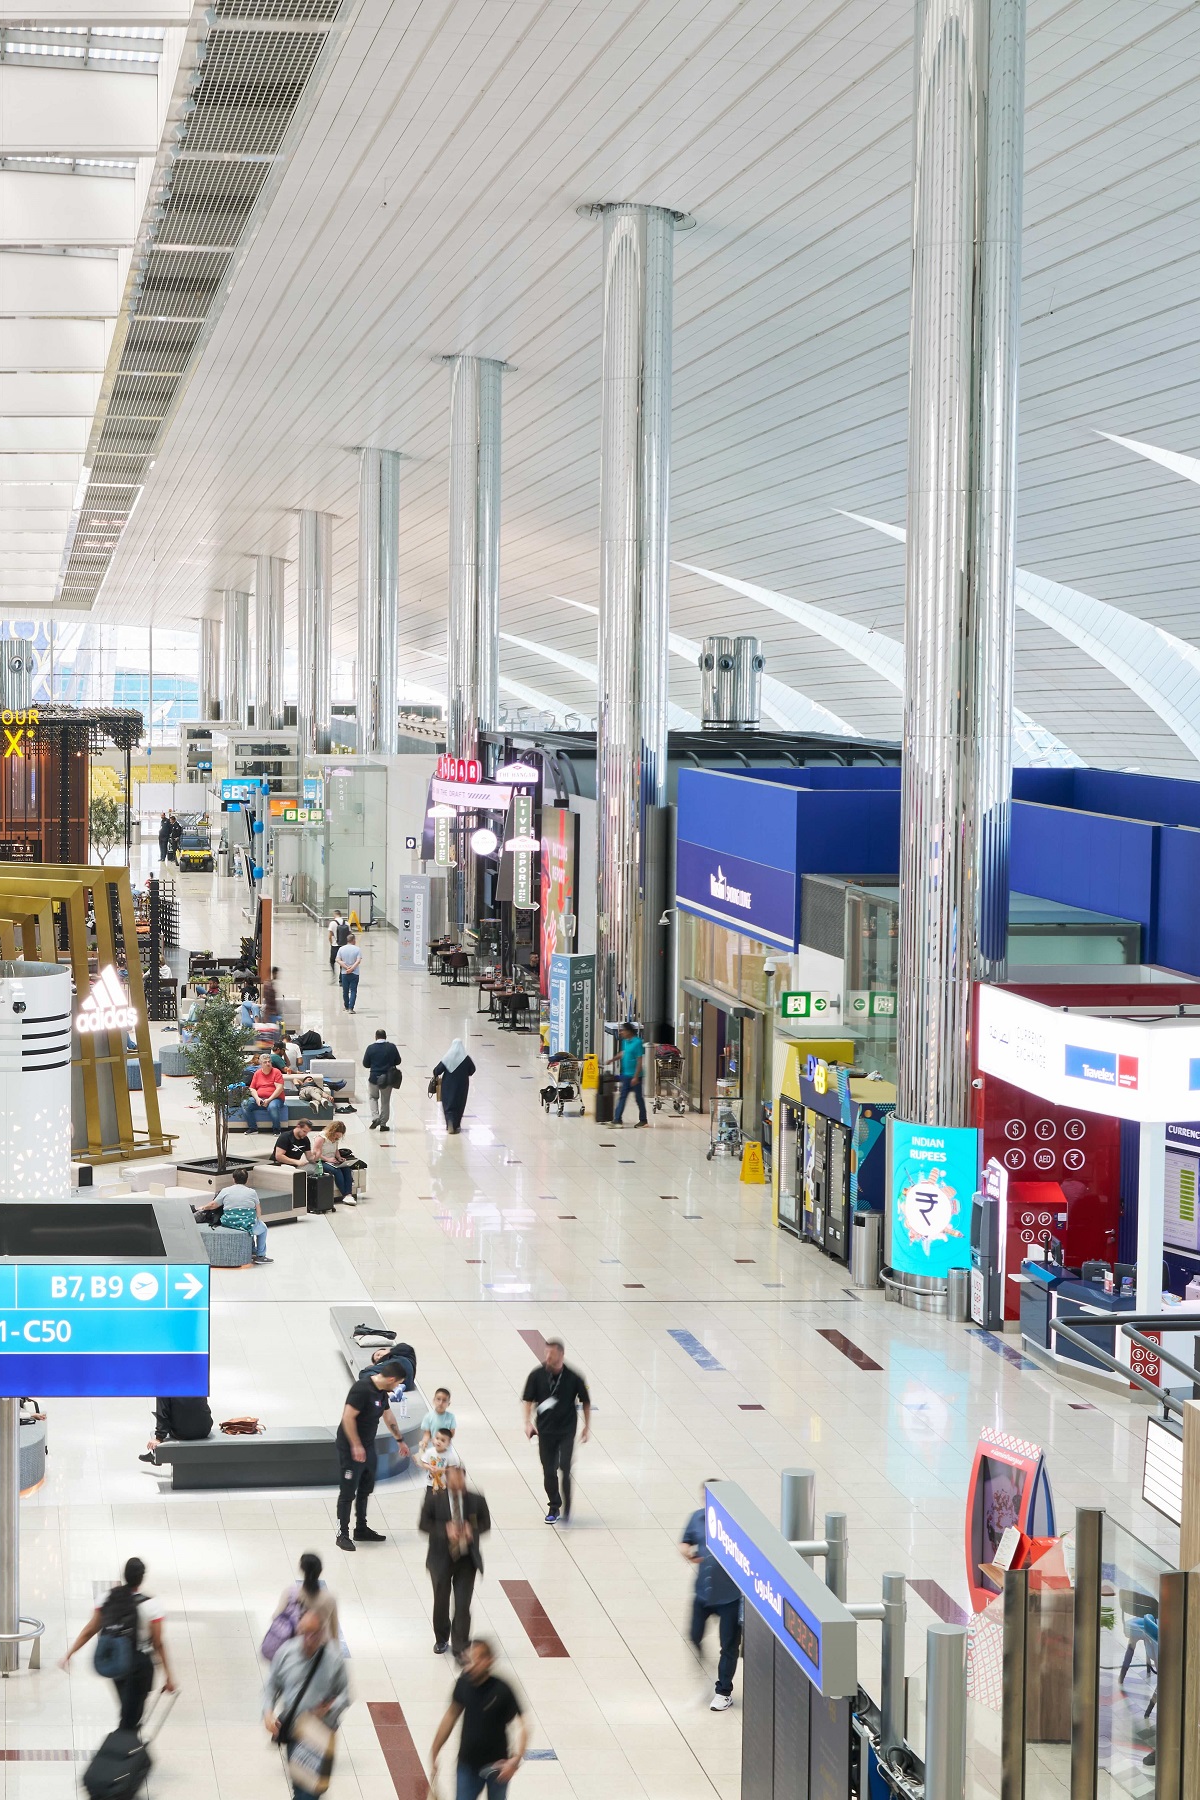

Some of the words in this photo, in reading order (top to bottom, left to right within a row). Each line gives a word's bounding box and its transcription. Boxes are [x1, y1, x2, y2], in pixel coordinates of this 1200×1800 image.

[572, 981, 584, 992] 13
[76, 1005, 138, 1033] adidas
[1082, 1063, 1115, 1082] Travelex
[911, 1136, 945, 1149] INDIAN
[909, 1149, 947, 1163] RUPEES
[1038, 1155, 1051, 1164] AED
[51, 1276, 85, 1302] B7,
[90, 1275, 123, 1298] B9
[717, 1519, 751, 1577] Departures
